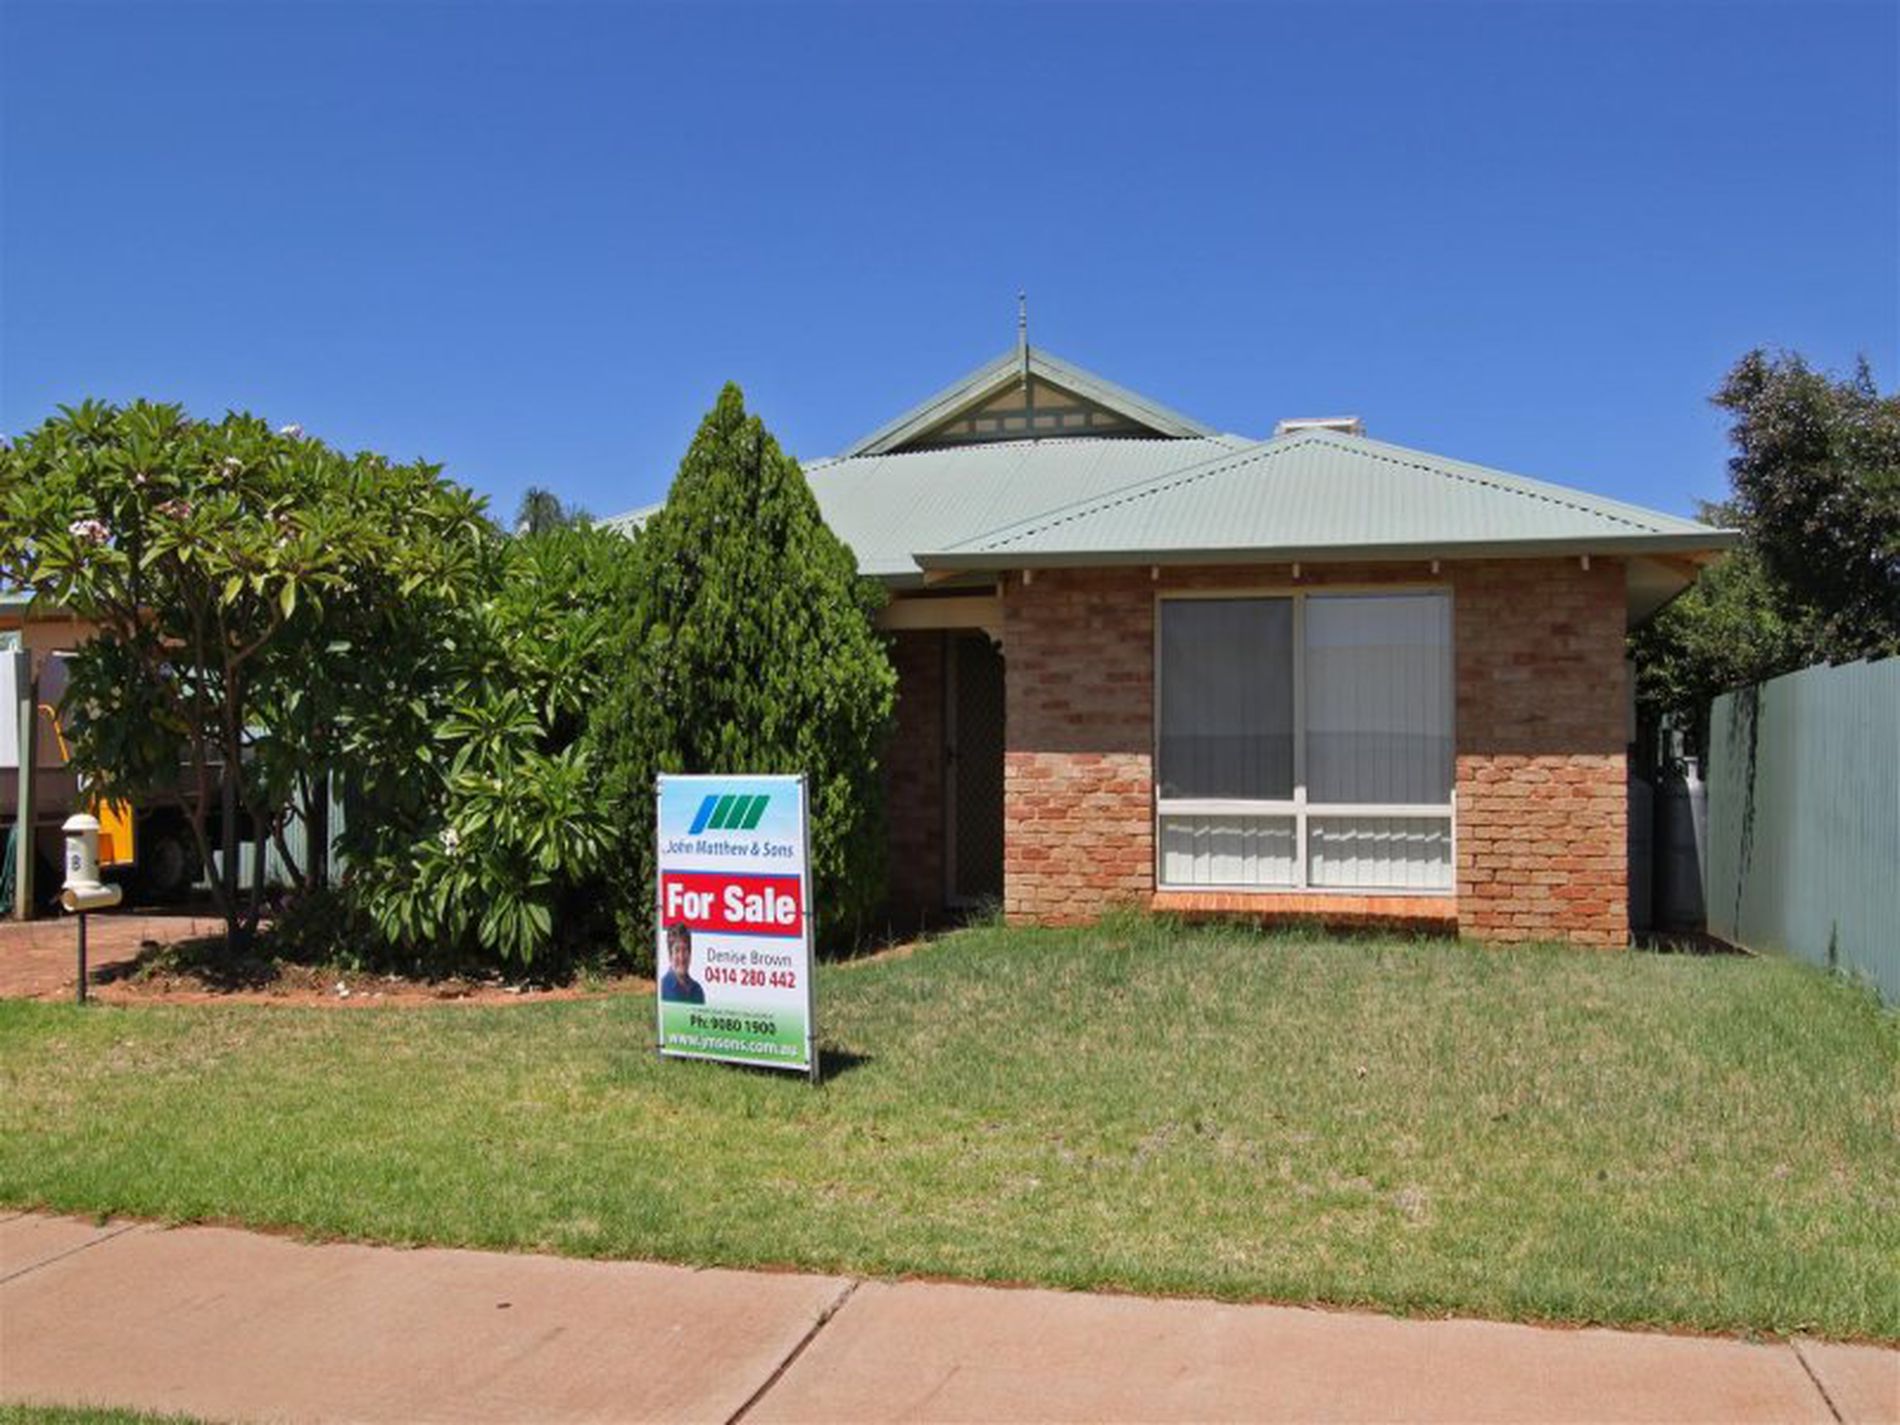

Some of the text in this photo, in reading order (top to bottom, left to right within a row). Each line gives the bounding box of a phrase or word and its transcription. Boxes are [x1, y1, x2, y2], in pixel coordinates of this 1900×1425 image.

[663, 841, 793, 858] John Matthew & Sons
[667, 882, 797, 925] For Sale
[707, 947, 792, 967] Denise Brown
[705, 967, 796, 988] 0414 280 442
